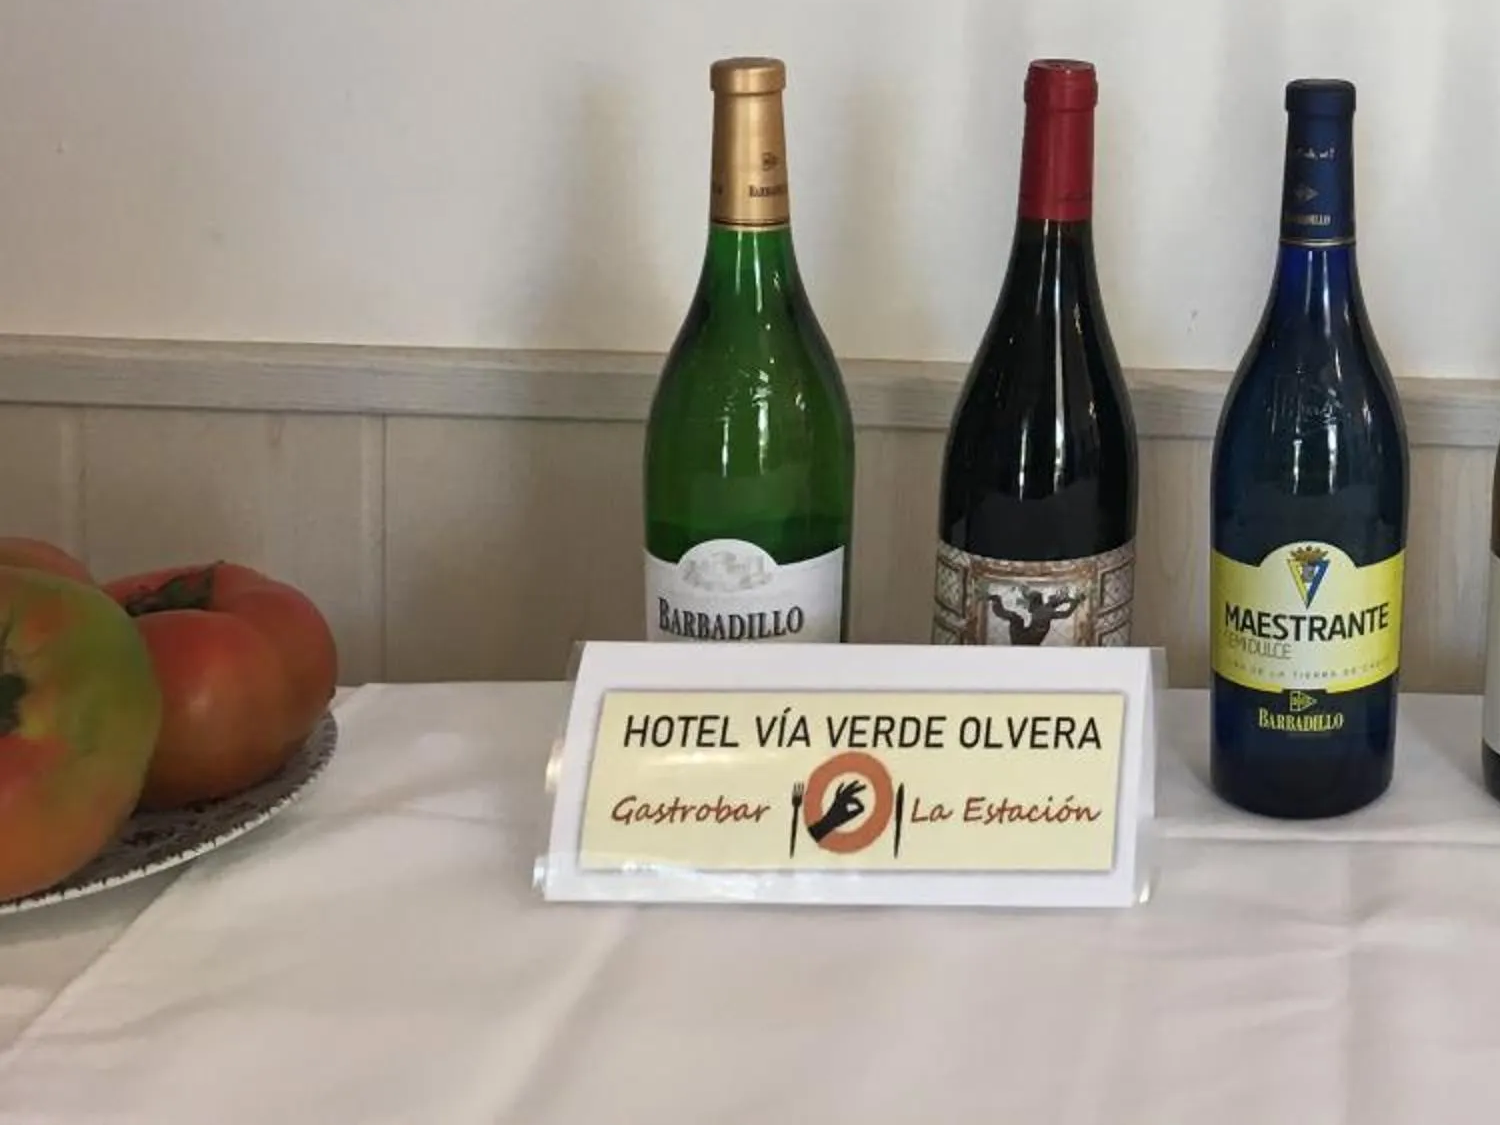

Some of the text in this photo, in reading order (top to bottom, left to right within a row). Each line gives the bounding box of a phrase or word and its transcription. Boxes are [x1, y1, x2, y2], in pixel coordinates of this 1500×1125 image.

[657, 595, 805, 641] BARBADILLO
[1225, 602, 1390, 642] MAESTRANTE
[623, 706, 1103, 751] HOTEL VÍA VERDE OLVERA
[611, 794, 1103, 825] Gastrobar La Estación
